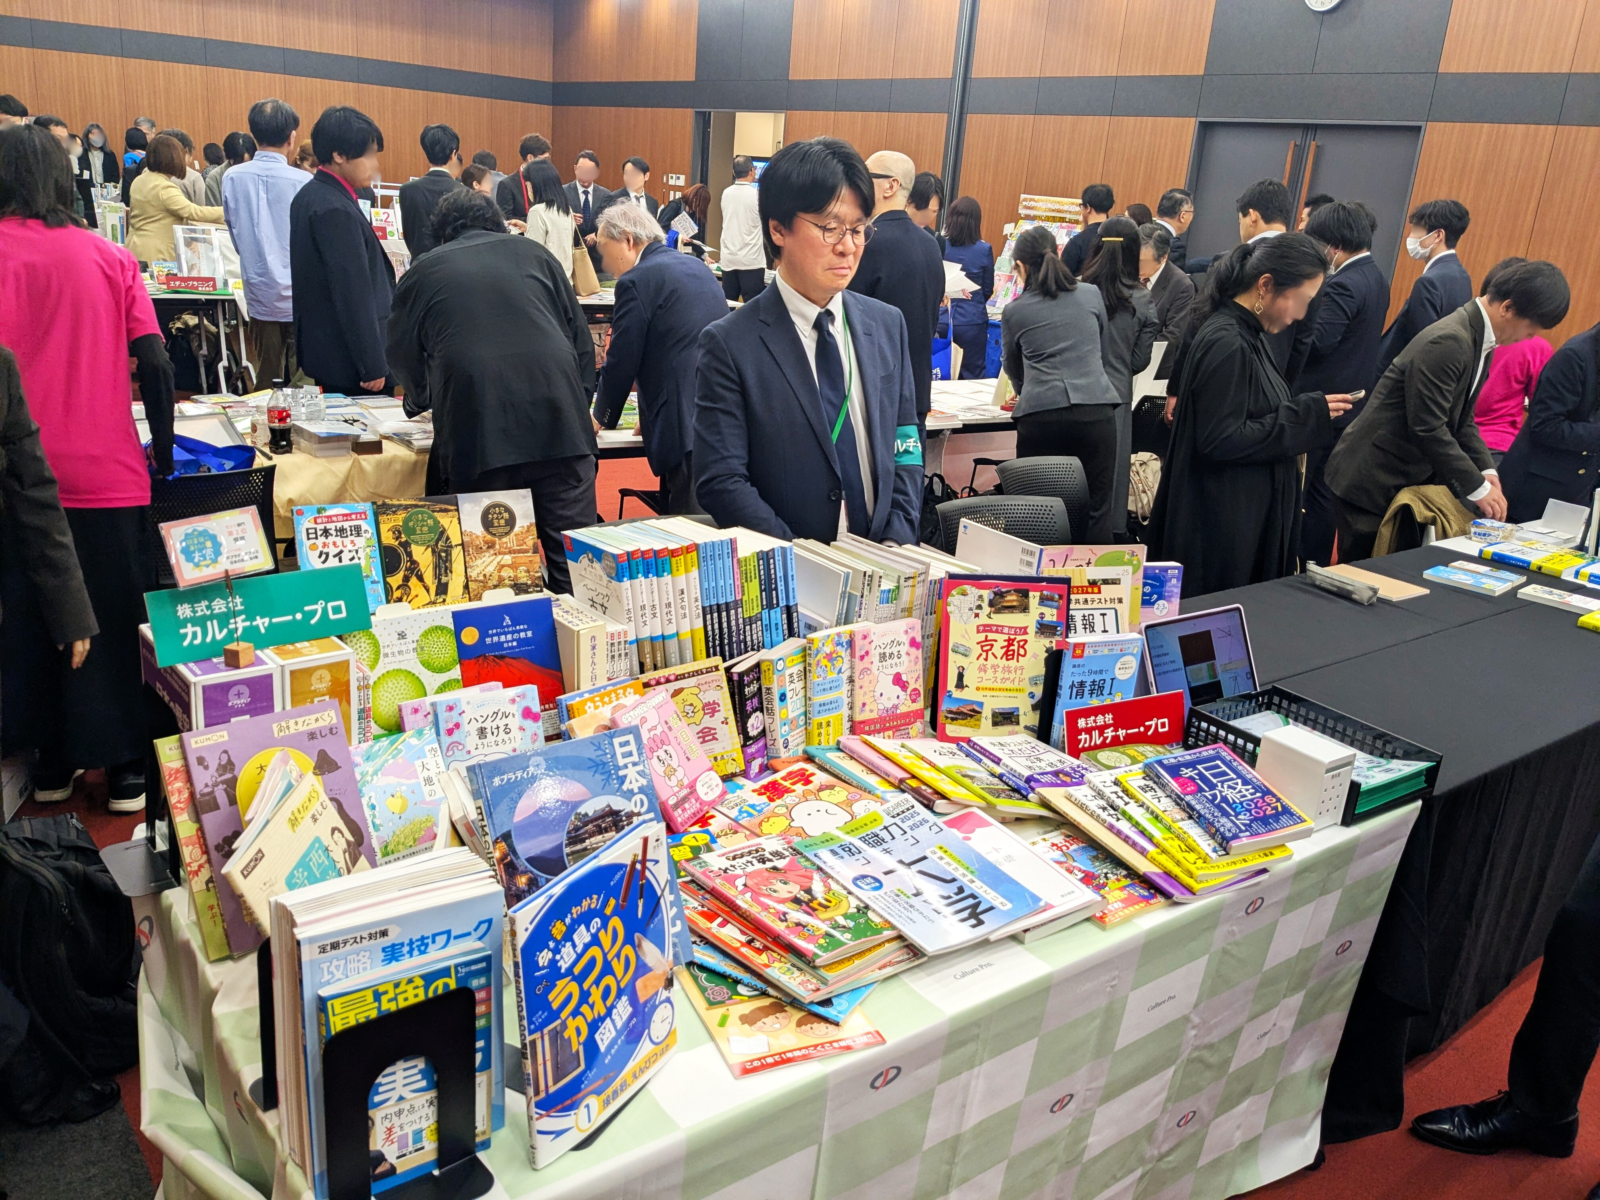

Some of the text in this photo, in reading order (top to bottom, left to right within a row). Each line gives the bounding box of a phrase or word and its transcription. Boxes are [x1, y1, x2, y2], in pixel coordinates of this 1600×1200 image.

[382, 212, 390, 223] 2
[306, 524, 370, 540] 日本地理の
[322, 540, 356, 549] おもしろ
[176, 595, 244, 619] 株式会社
[650, 604, 658, 620] 古文
[664, 602, 674, 626] 現代文
[679, 588, 688, 620] 漢文句法
[694, 596, 702, 620] 英文法
[179, 600, 348, 646] カルチャー・プロ
[625, 608, 633, 624] 古文
[640, 604, 648, 628] 現代文
[485, 631, 533, 645] 世界遺産の教室
[977, 624, 1024, 636] テーマで選ぼう!
[874, 638, 906, 650] ハングルを
[976, 634, 1029, 663] 京都
[878, 650, 902, 663] 読める
[684, 666, 717, 678] やさしく学べる
[976, 664, 1026, 676] 修学旅行
[976, 674, 1026, 686] コースガイド
[1070, 668, 1110, 676] たった9時間で
[594, 691, 624, 708] うさまる
[746, 696, 759, 714] 英検
[276, 710, 335, 738] 解きながら
[467, 708, 516, 725] ハングルを
[764, 686, 777, 748] 英会話フレーズ
[1077, 712, 1114, 730] 株式会社
[194, 733, 226, 746] KUMON
[306, 726, 338, 742] 楽しむ
[476, 723, 512, 740] 書ける
[669, 713, 700, 760] 韓国語
[1077, 718, 1170, 748] カルチャー・プロ
[418, 760, 436, 798] 大地の
[752, 768, 817, 802] 漢字
[1196, 760, 1262, 803] 日経
[1179, 767, 1250, 831] キーワード
[1232, 795, 1277, 812] 2026
[310, 800, 328, 826] 楽しむ
[898, 810, 921, 824] 2025
[1237, 802, 1282, 820] 2027
[907, 818, 930, 832] 2026
[242, 850, 264, 877] KUMON
[810, 890, 848, 912] run
[318, 928, 390, 955] 定期テスト対策
[380, 917, 494, 967] 実技ワーク
[556, 917, 601, 973] 道具の
[318, 950, 372, 984] 攻略
[548, 916, 625, 1010] うつり
[953, 961, 994, 980] Culture Pro.
[564, 944, 636, 1053] かわり
[594, 995, 633, 1052] 図鑑
[373, 1056, 428, 1108] 実
[583, 1102, 592, 1124] 1
